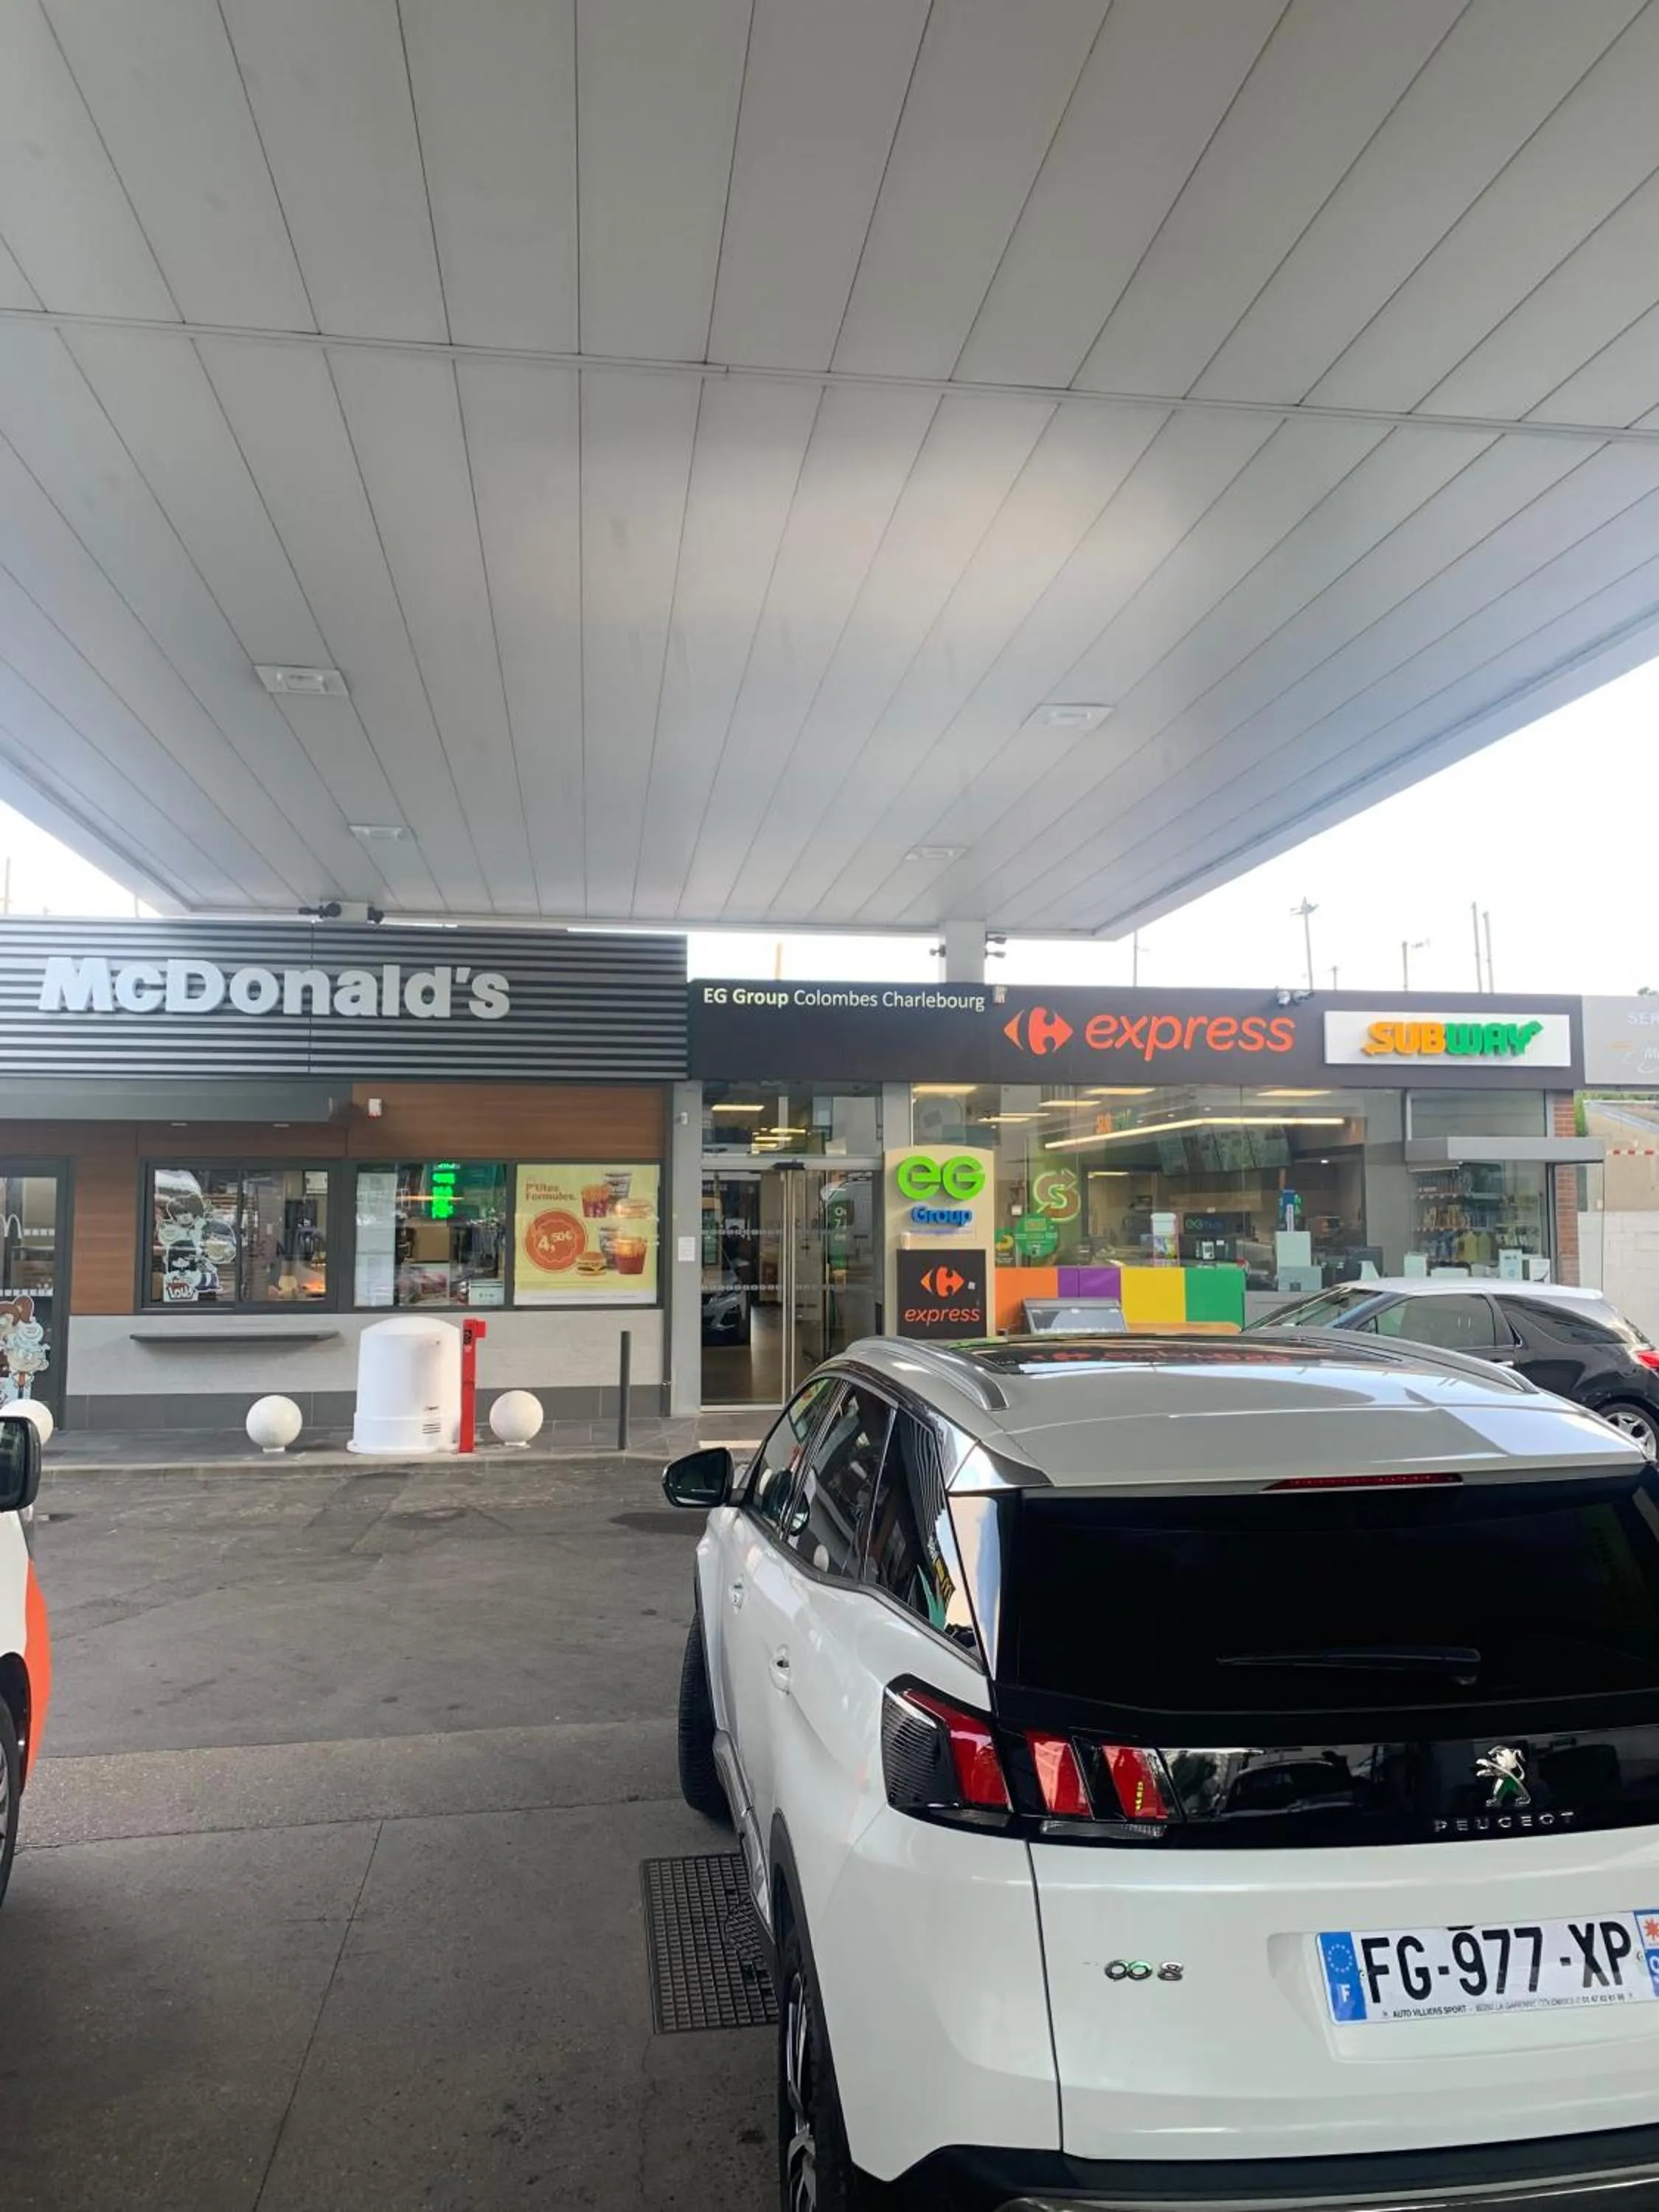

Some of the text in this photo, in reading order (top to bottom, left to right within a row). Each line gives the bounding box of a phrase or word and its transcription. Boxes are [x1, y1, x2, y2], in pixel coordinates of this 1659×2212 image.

[38, 957, 510, 1020] McDonald's
[703, 988, 986, 1012] EG Group Colombes Charlebourg
[1085, 1014, 1296, 1062] express
[1361, 1020, 1544, 1057] SUBWAY
[911, 1206, 973, 1227] Group
[905, 1307, 981, 1326] express
[1434, 1811, 1574, 1832] PEUGEOT
[1340, 1983, 1350, 2003] F
[1393, 2009, 1412, 2018] AUTO
[1444, 2005, 1467, 2014] SPORT
